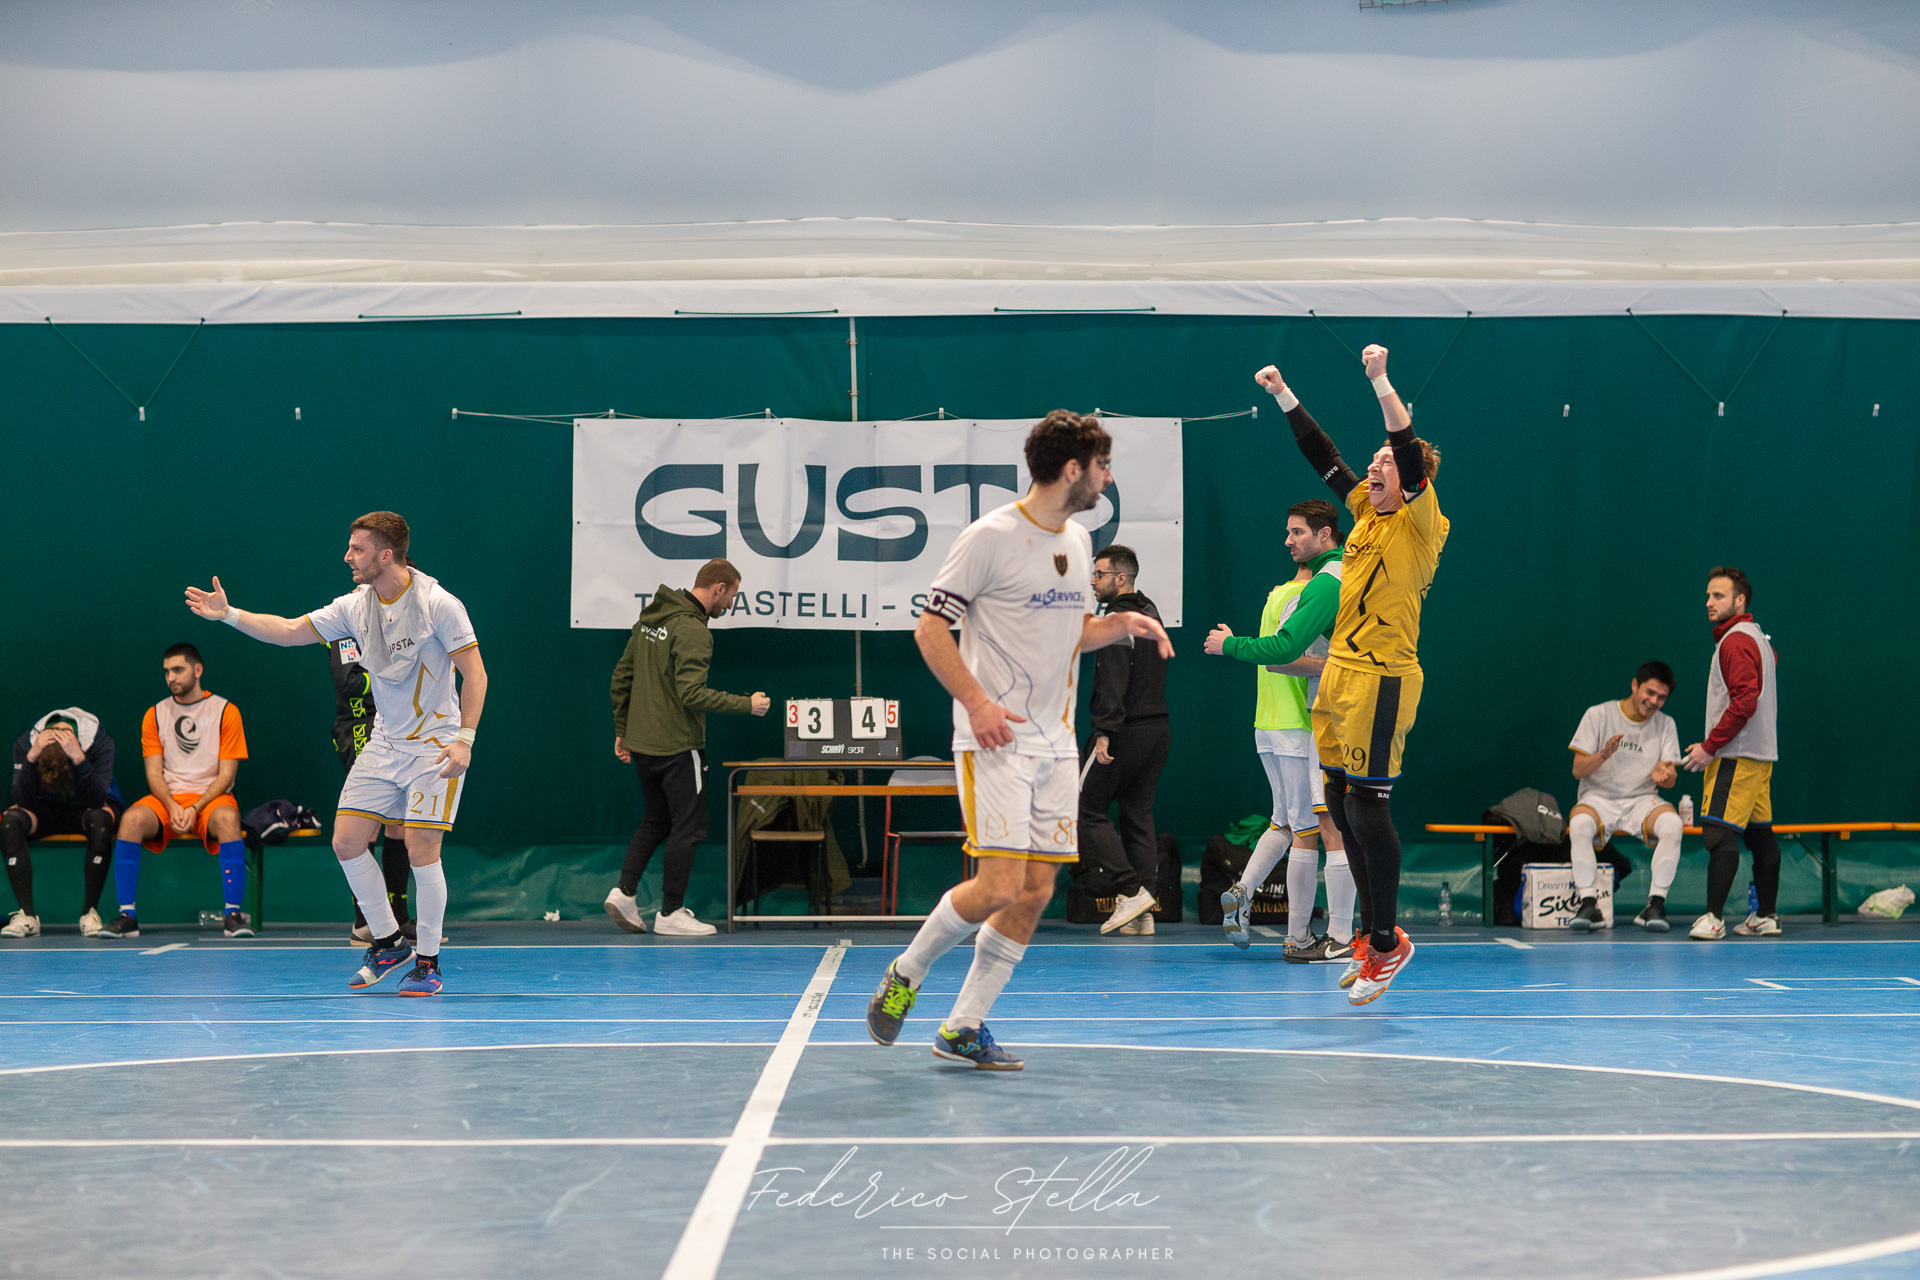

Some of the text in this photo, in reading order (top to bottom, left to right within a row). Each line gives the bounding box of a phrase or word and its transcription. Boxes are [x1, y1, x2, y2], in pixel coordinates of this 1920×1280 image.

[719, 590, 867, 618] ASTELLI
[389, 637, 415, 655] IPSTA
[788, 705, 896, 733] 3 3 4 5
[1342, 743, 1367, 772] 29
[1619, 739, 1643, 753] IPSTA
[410, 791, 440, 817] 21
